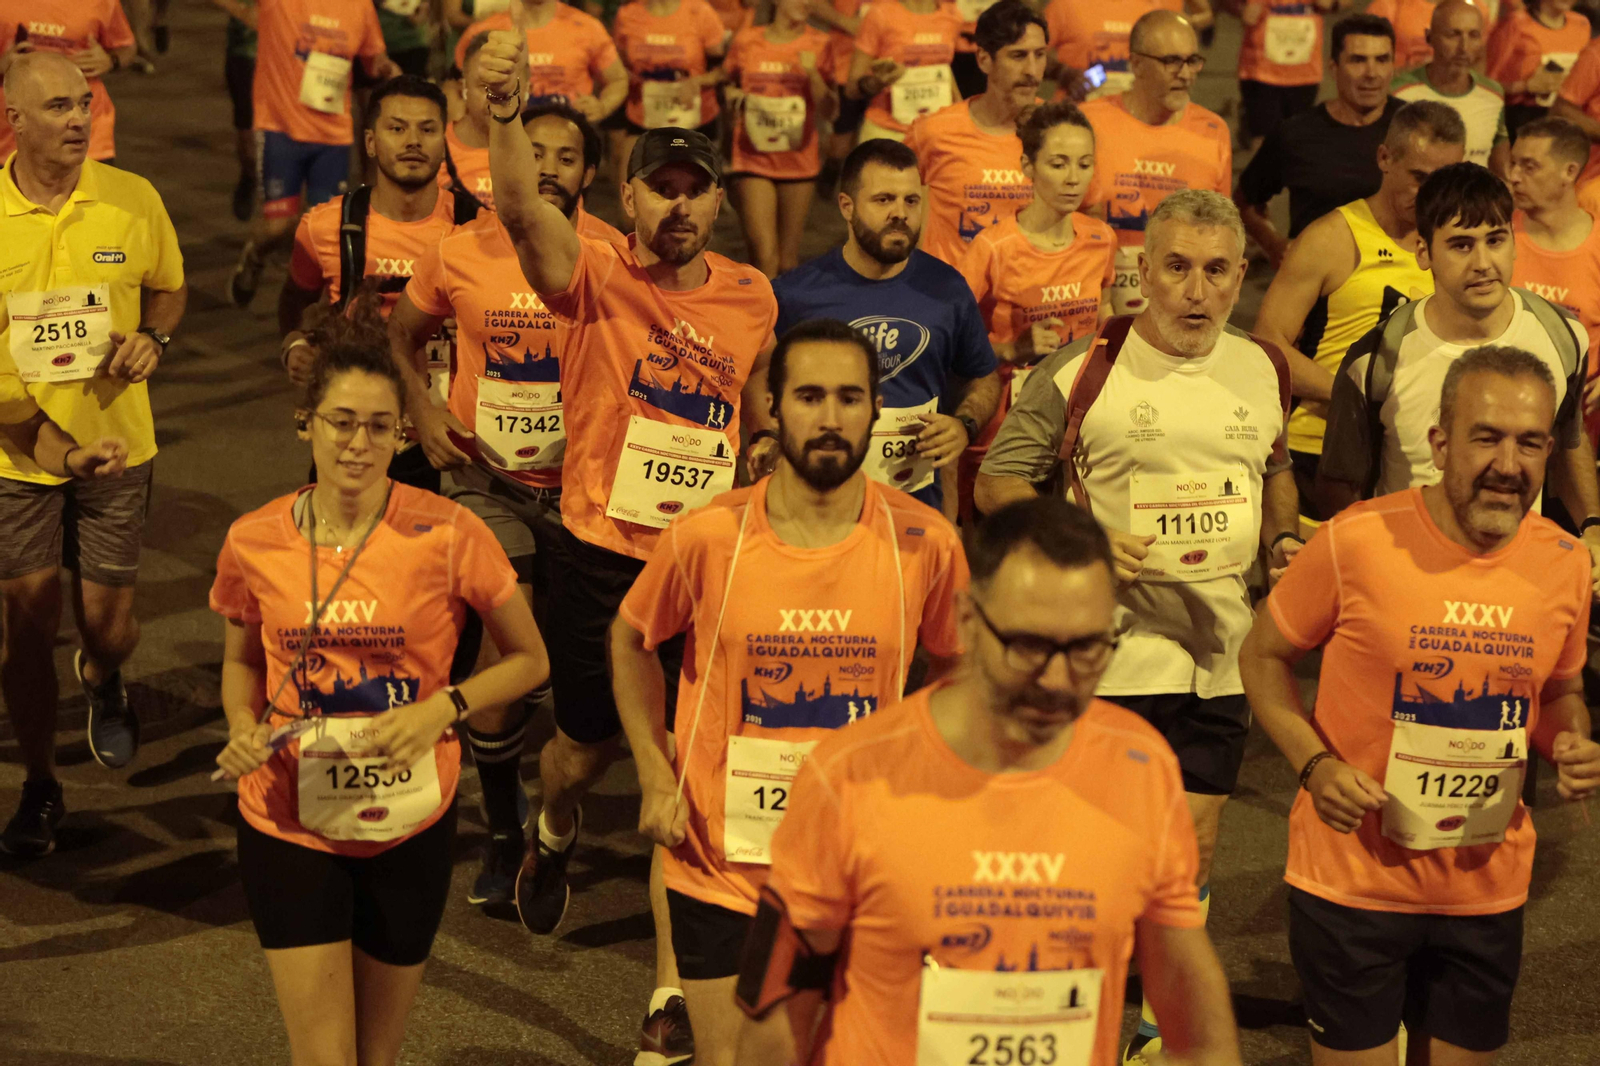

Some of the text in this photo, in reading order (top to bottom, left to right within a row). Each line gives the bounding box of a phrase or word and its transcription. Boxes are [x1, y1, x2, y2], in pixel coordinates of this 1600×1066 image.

[510, 292, 545, 310] XX
[1041, 282, 1081, 303] XXXV
[485, 310, 529, 318] CARRERA
[33, 320, 87, 343] 2518
[654, 335, 736, 375] GUADALQUIVIR
[693, 344, 734, 364] NOCNA
[630, 389, 648, 401] 2025
[495, 415, 560, 434] 17342
[643, 460, 714, 490] 19537
[1157, 511, 1229, 535] 11109
[304, 600, 377, 624] XXXV
[779, 609, 852, 632] XXXV
[1442, 600, 1514, 628] XXXV
[277, 626, 405, 637] CARRRA NOCTURNA
[747, 634, 877, 644] CARRERA NOCTURNA
[1410, 625, 1534, 644] CARRERA NOCTURNA
[756, 646, 876, 658] GUADALQUIVIR
[1419, 638, 1533, 658] GUADALQUIVIR
[1394, 711, 1416, 721] 2025
[1417, 771, 1499, 797] 11229
[754, 786, 787, 811] 12
[972, 851, 1065, 883] XXXV
[934, 886, 1096, 900] CARRERA NOCTURNA
[946, 902, 1095, 919] GUADALQUIVIR
[968, 1033, 1057, 1066] 2563
